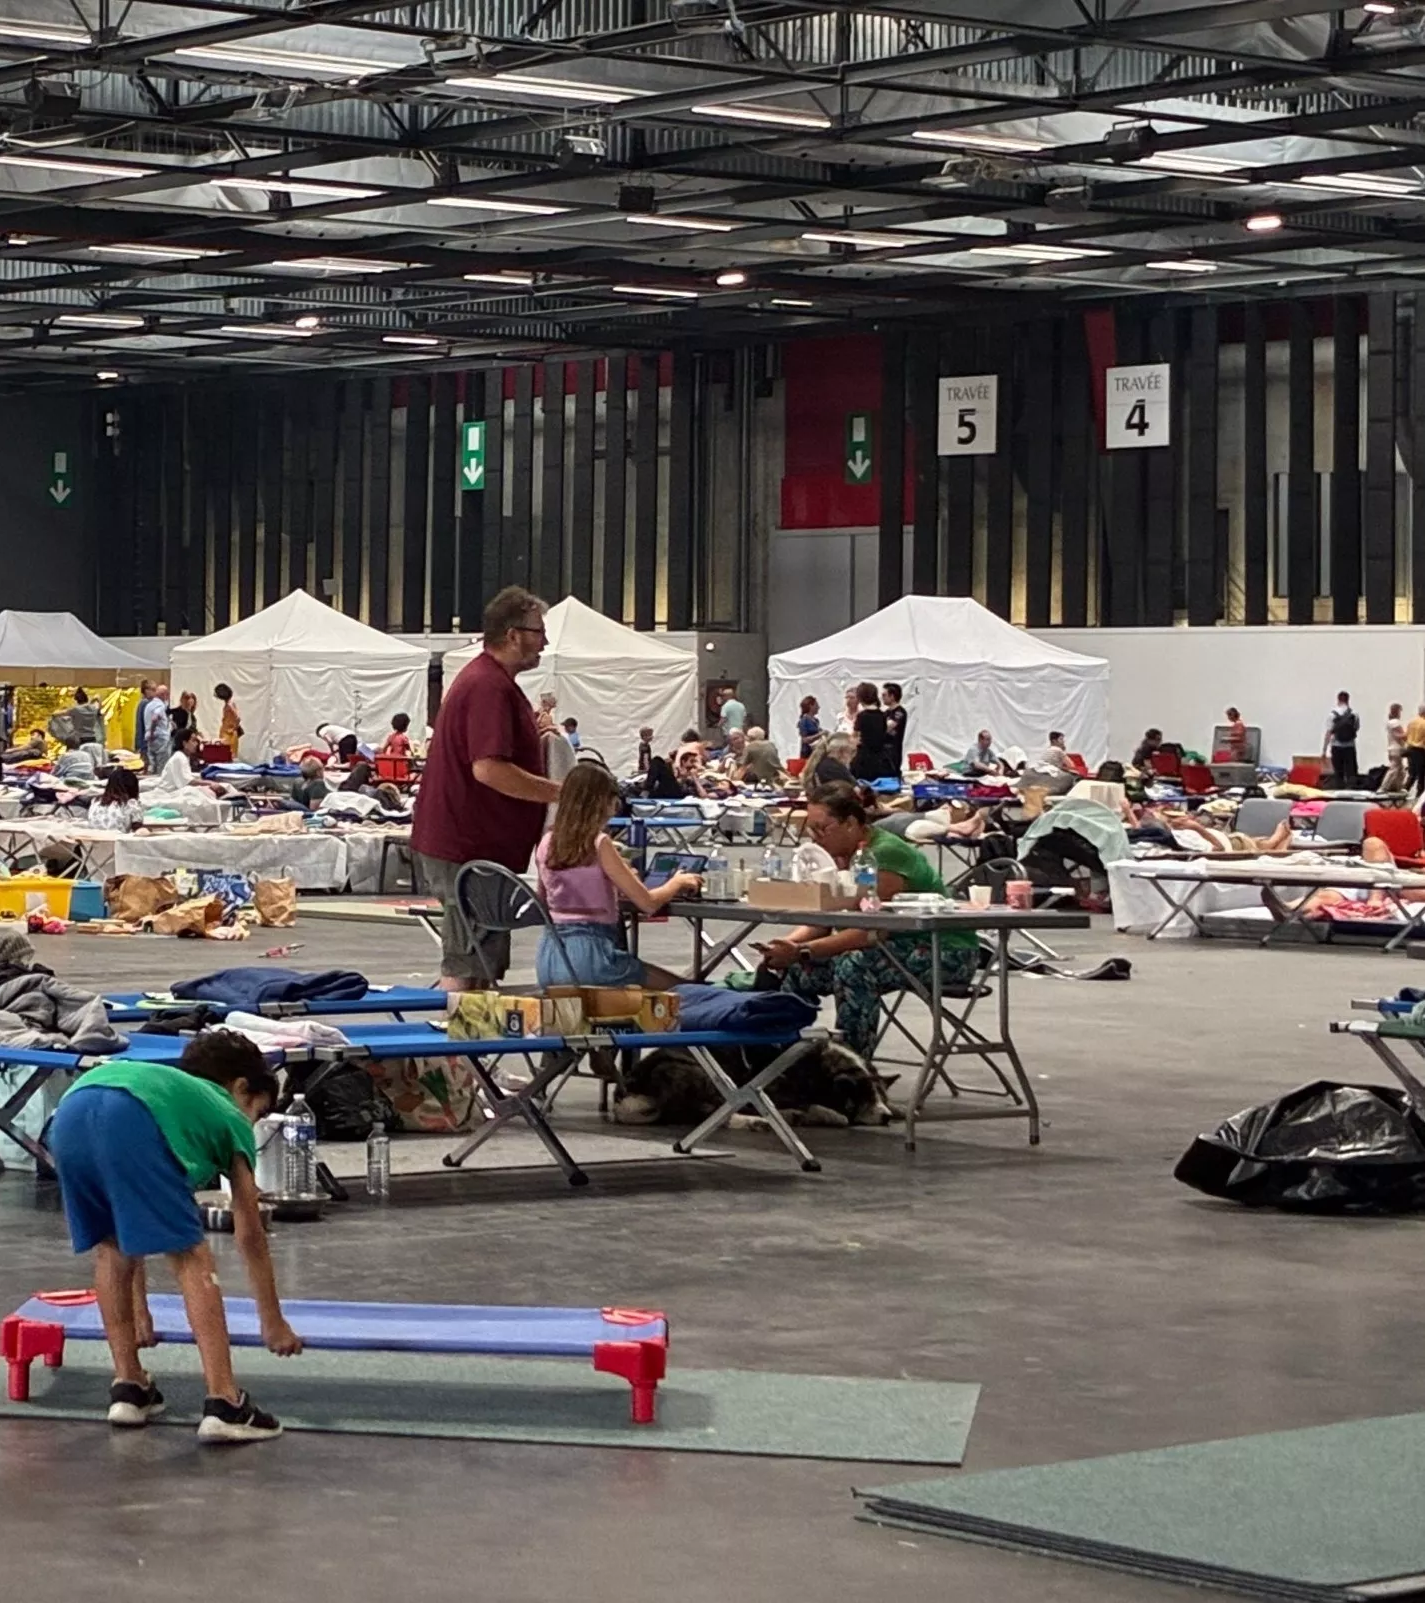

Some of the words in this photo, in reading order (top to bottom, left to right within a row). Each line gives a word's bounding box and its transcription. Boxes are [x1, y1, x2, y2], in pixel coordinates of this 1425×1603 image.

[947, 383, 990, 401] TRAVÉE
[1114, 372, 1163, 392] TRAVÉE
[957, 408, 977, 445] 5
[1125, 398, 1150, 437] 4
